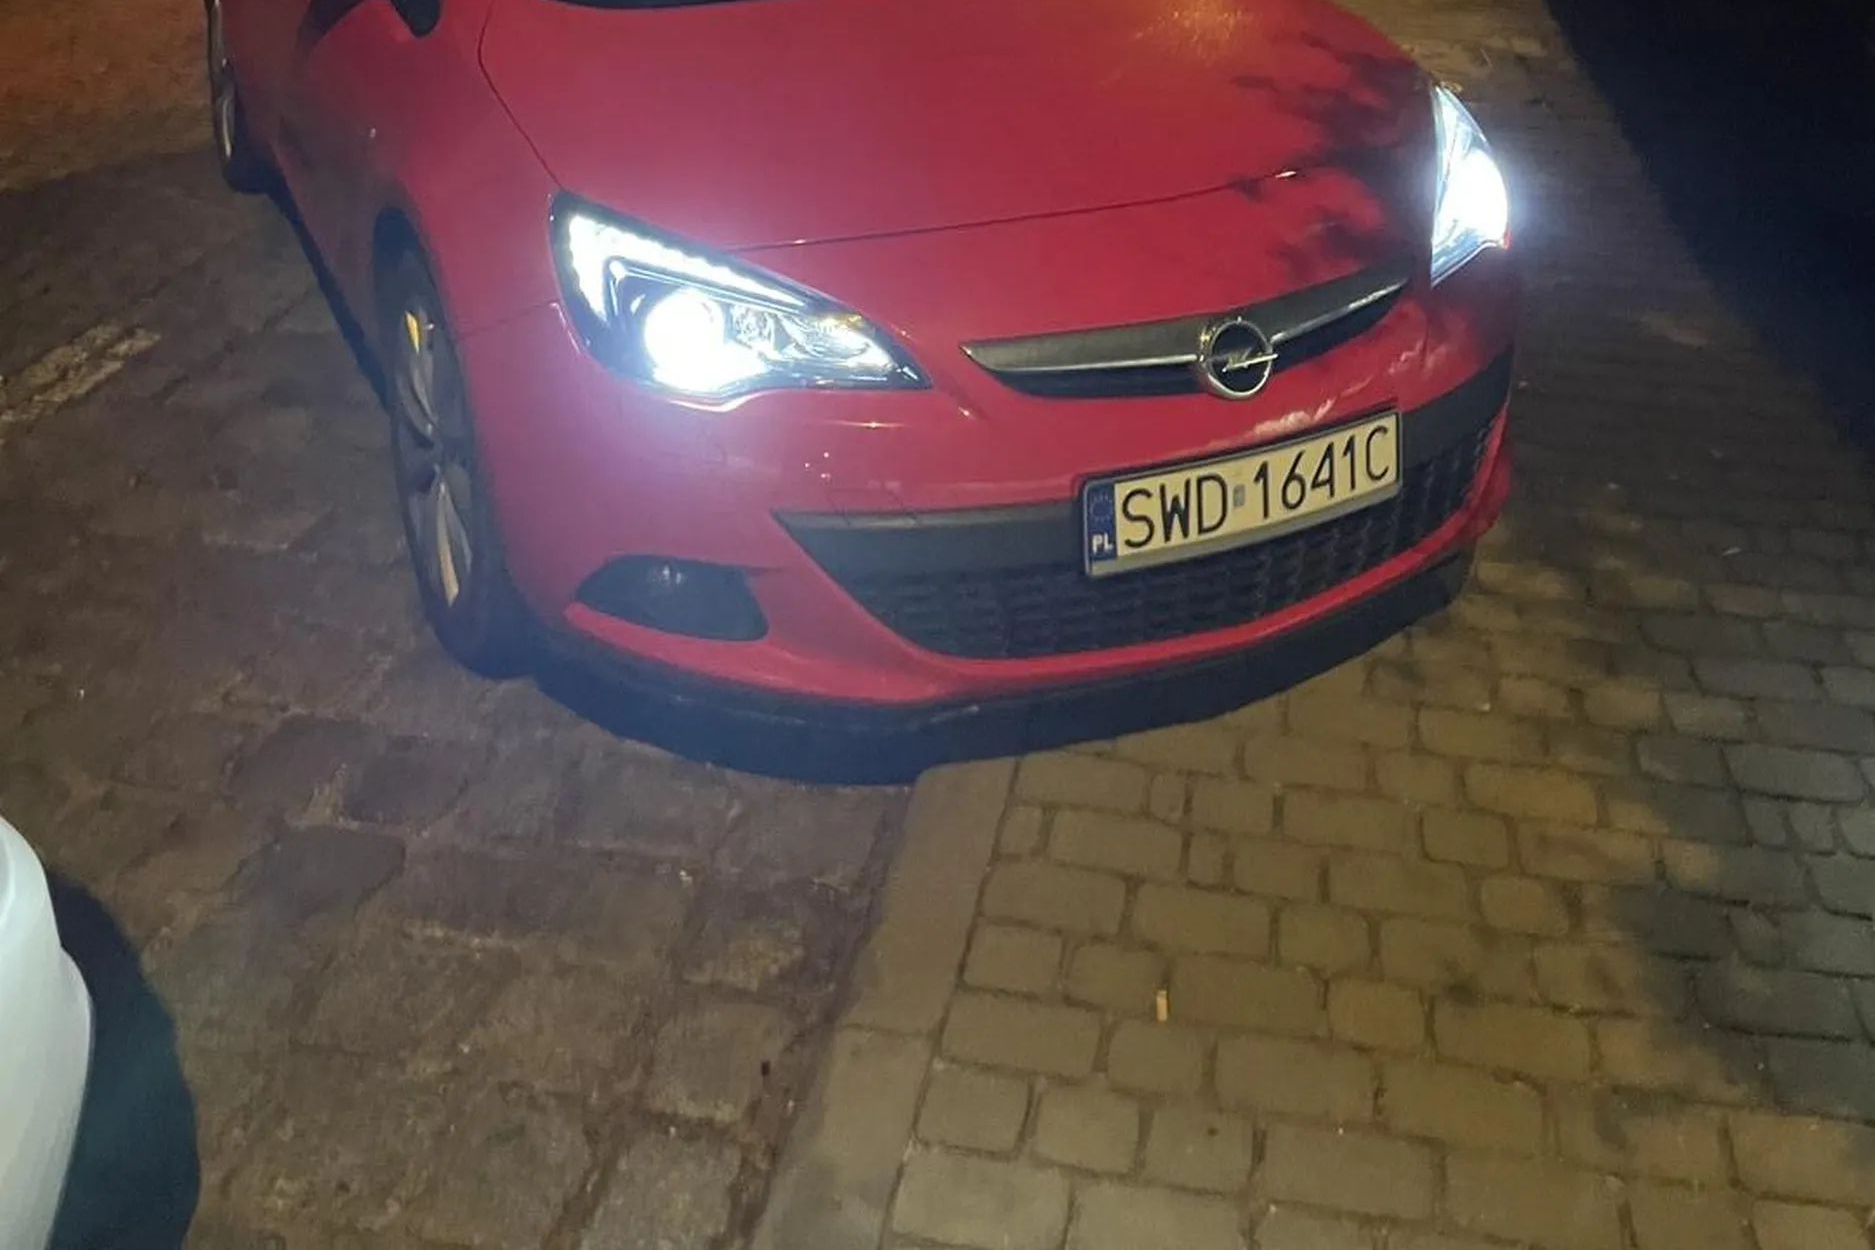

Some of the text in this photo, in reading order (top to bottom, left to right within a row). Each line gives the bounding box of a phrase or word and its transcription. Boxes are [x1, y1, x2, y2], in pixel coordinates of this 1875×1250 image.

[1122, 425, 1390, 548] SWD 1641C
[1092, 533, 1113, 553] PL
